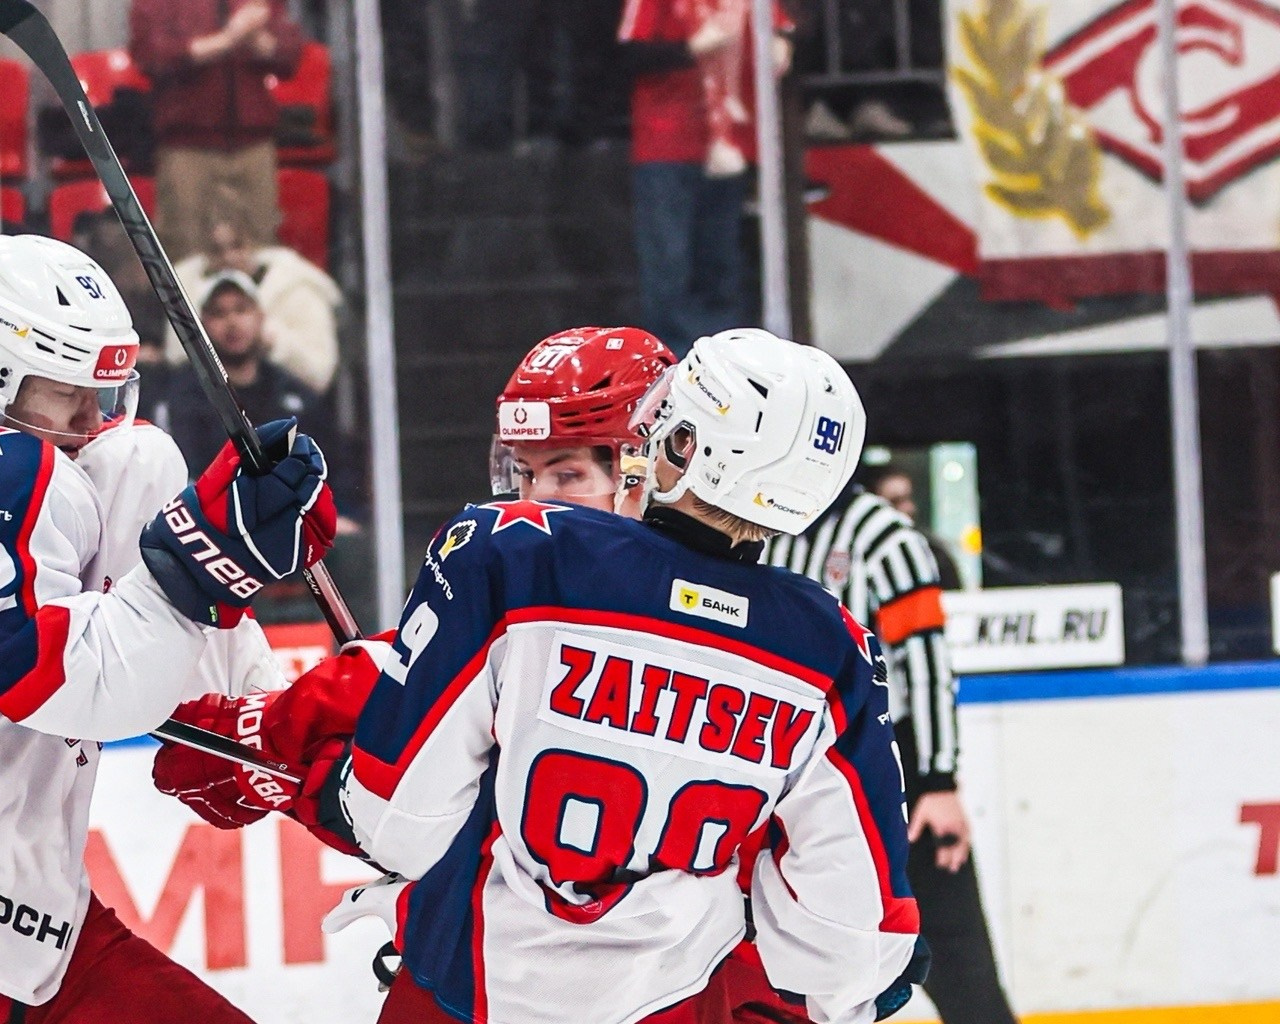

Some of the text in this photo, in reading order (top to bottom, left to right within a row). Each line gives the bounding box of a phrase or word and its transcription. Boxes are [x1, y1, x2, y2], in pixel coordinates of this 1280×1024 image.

[502, 427, 545, 436] OLIMPBET
[813, 415, 842, 456] 99
[702, 598, 741, 618] БАНК
[549, 643, 817, 770] ZAITSEV
